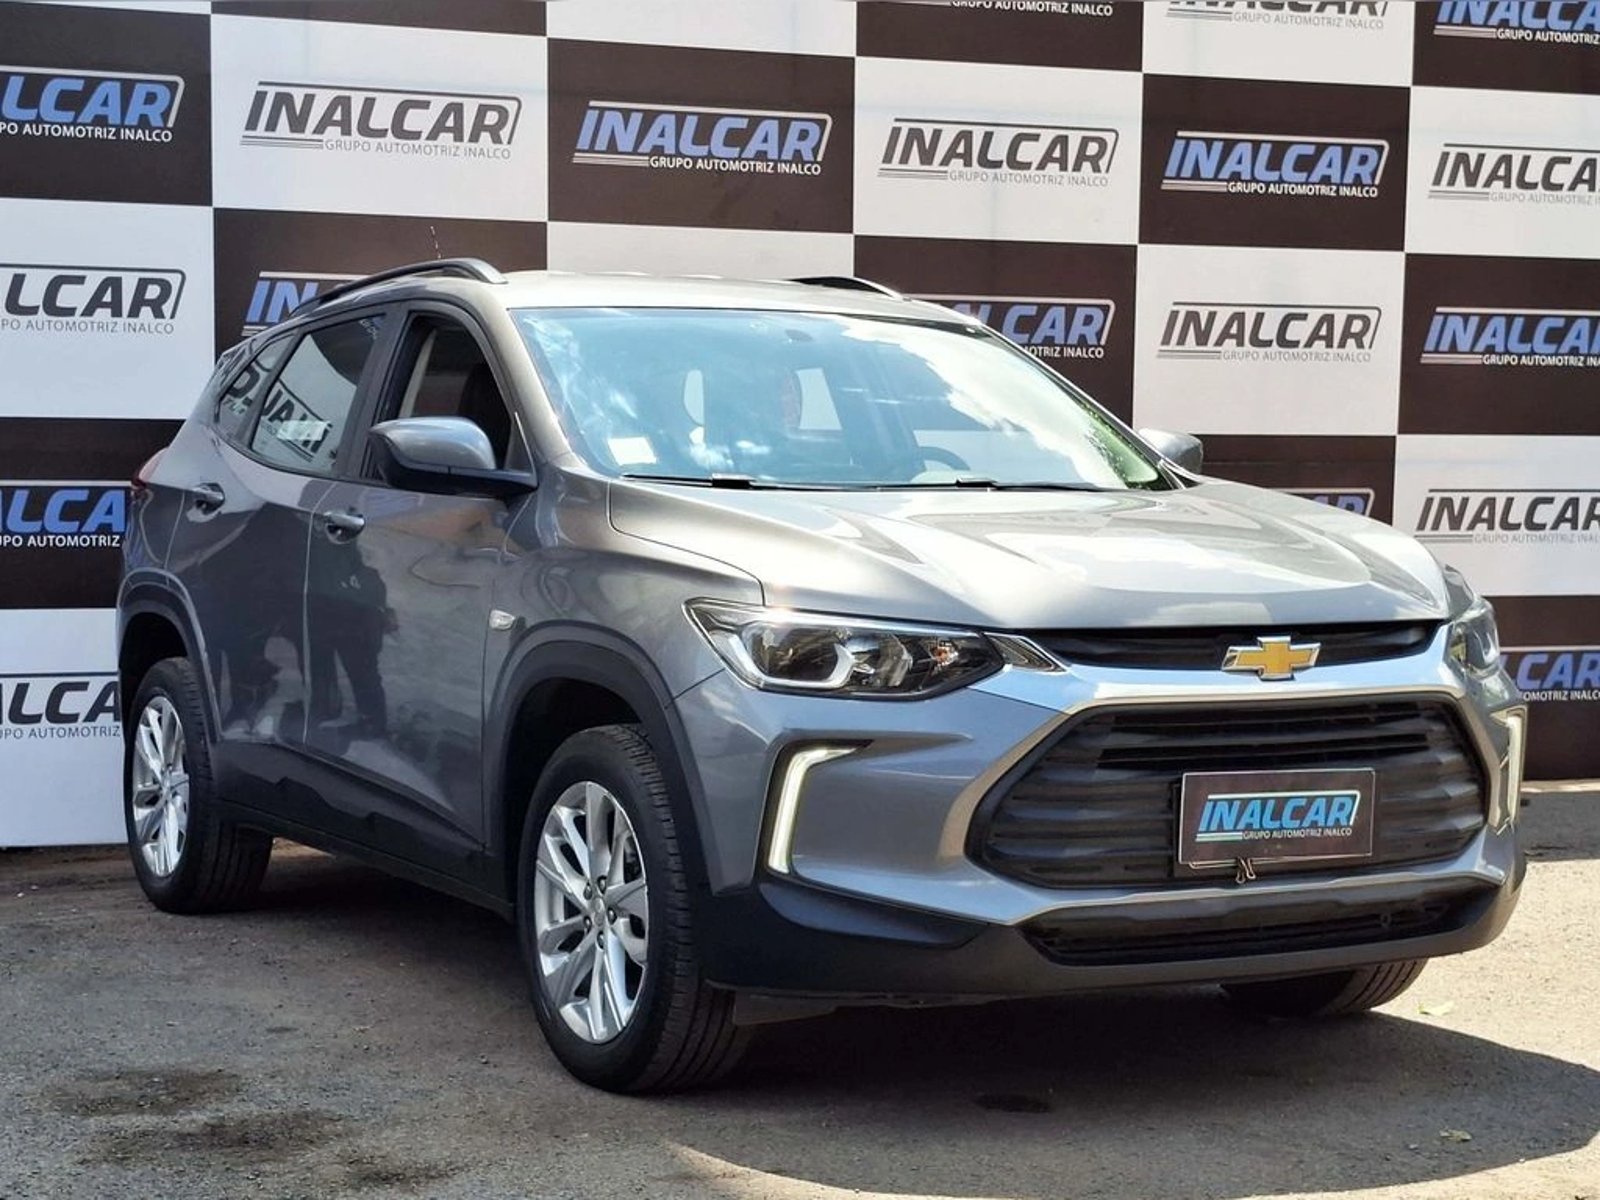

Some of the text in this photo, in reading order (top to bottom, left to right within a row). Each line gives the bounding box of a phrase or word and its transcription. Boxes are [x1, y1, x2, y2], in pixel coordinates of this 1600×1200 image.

[995, 1, 1070, 14] AUTOMOTRIZ
[1071, 4, 1113, 16] INALCO
[1233, 12, 1384, 29] GRUPO AUTOMOTRIZ INALCO
[1497, 28, 1600, 45] GRUPO AUTOMOTRIZ
[244, 90, 511, 145] INALCAR
[22, 123, 116, 140] AUTOMOTRIZ
[120, 128, 173, 143] INALCO
[576, 109, 821, 161] INALCAR
[325, 138, 511, 160] GRUPO AUTOMOTRIZ INALCO
[882, 126, 1108, 173] INALCAR
[650, 156, 822, 175] GRUPO AUTOMOTRIZ INALCO
[1164, 139, 1379, 185] INALCAR
[949, 171, 1108, 187] GRUPO AUTOMOTRIZ INALCO
[1431, 151, 1600, 192] INALCA
[1228, 182, 1378, 198] GRUPO AUTOMOTRIZ INALCO
[1490, 192, 1526, 202] GRUPO
[1529, 193, 1594, 205] AUTOMOTRIZ
[26, 319, 118, 333] AUTOMOTRIZ
[123, 323, 174, 334] INALCO
[1160, 310, 1371, 349] INALCAR
[1063, 347, 1104, 358] INALCO
[1223, 351, 1371, 363] GRUPO AUTOMOTRIZ INALCO
[1482, 354, 1518, 365] GRUPO
[1520, 355, 1584, 367] AUTOMOTRIZ
[0, 489, 126, 533] LCA
[27, 535, 120, 548] AUTOMOTRIZ
[1474, 533, 1508, 544] GRUPO
[0, 681, 121, 725] LCA
[1569, 690, 1600, 701] INALC
[28, 726, 121, 739] AUTOMOTRIZ
[1198, 797, 1354, 831] INALCAR
[1243, 827, 1352, 840] GRUPO AUTOMOTRIZ INALCO
